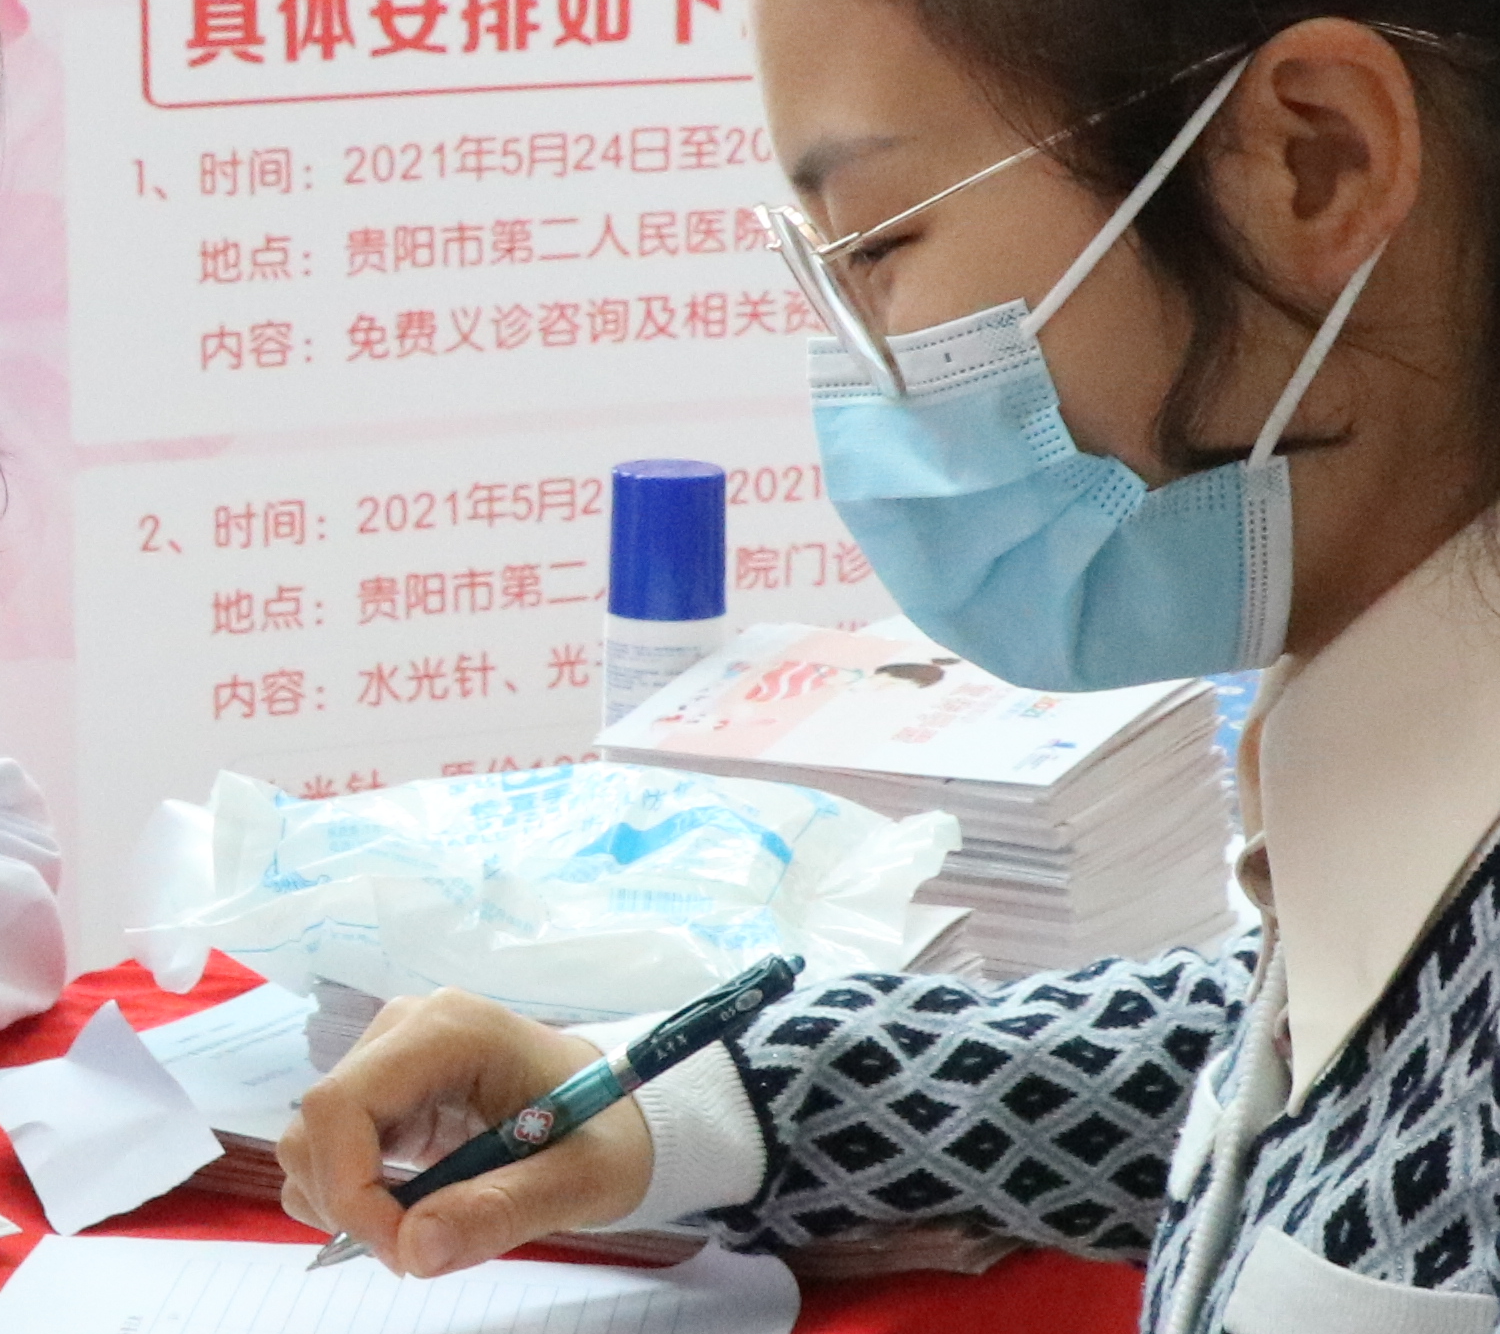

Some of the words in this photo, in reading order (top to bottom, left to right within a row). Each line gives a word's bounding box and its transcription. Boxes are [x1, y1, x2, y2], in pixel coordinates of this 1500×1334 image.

[212, 560, 606, 637] 地点：贵阳市第二
[213, 642, 604, 722] 内容：水光针、光
